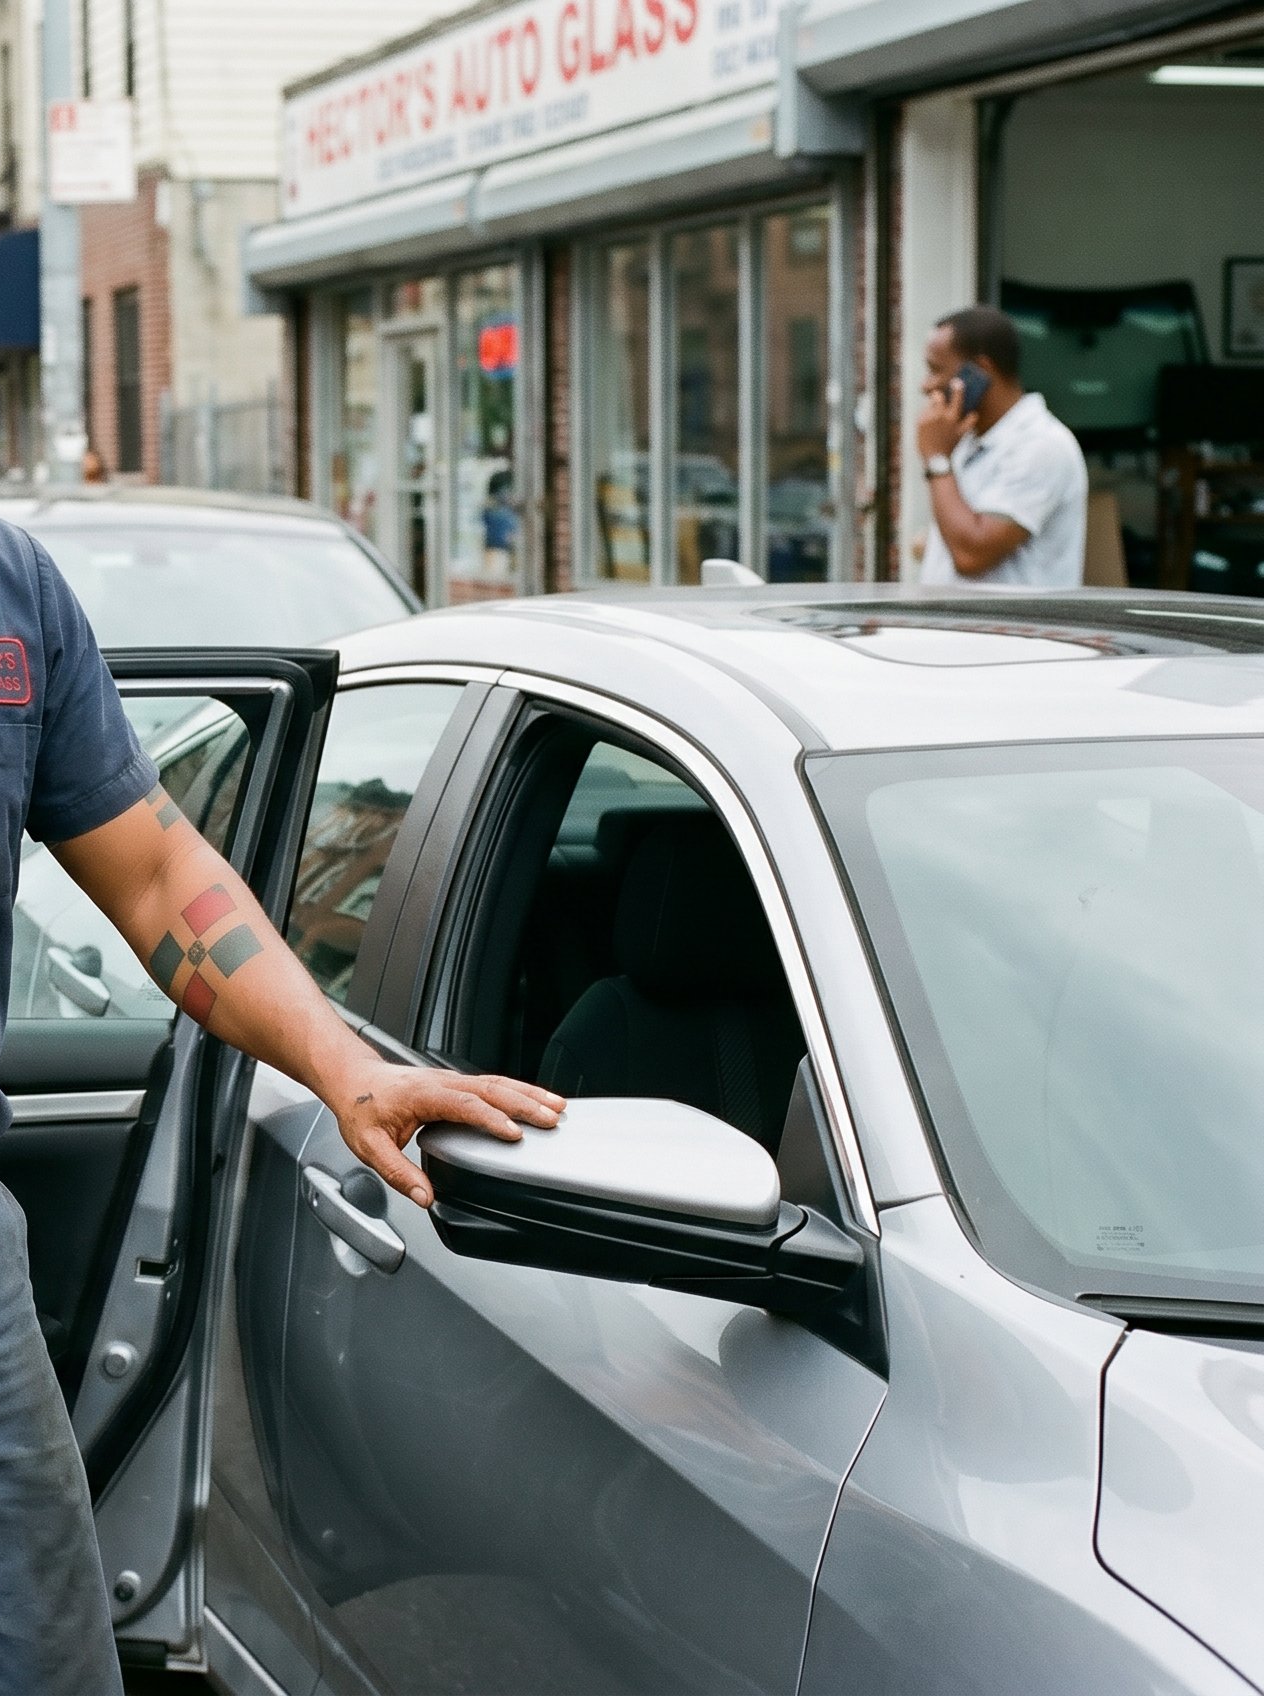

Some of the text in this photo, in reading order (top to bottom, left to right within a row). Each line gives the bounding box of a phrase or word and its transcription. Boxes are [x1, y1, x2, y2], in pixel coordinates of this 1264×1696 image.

[305, 60, 438, 172] HECTOR'S
[448, 18, 541, 120] AUTO
[557, 0, 698, 82] GLASS
